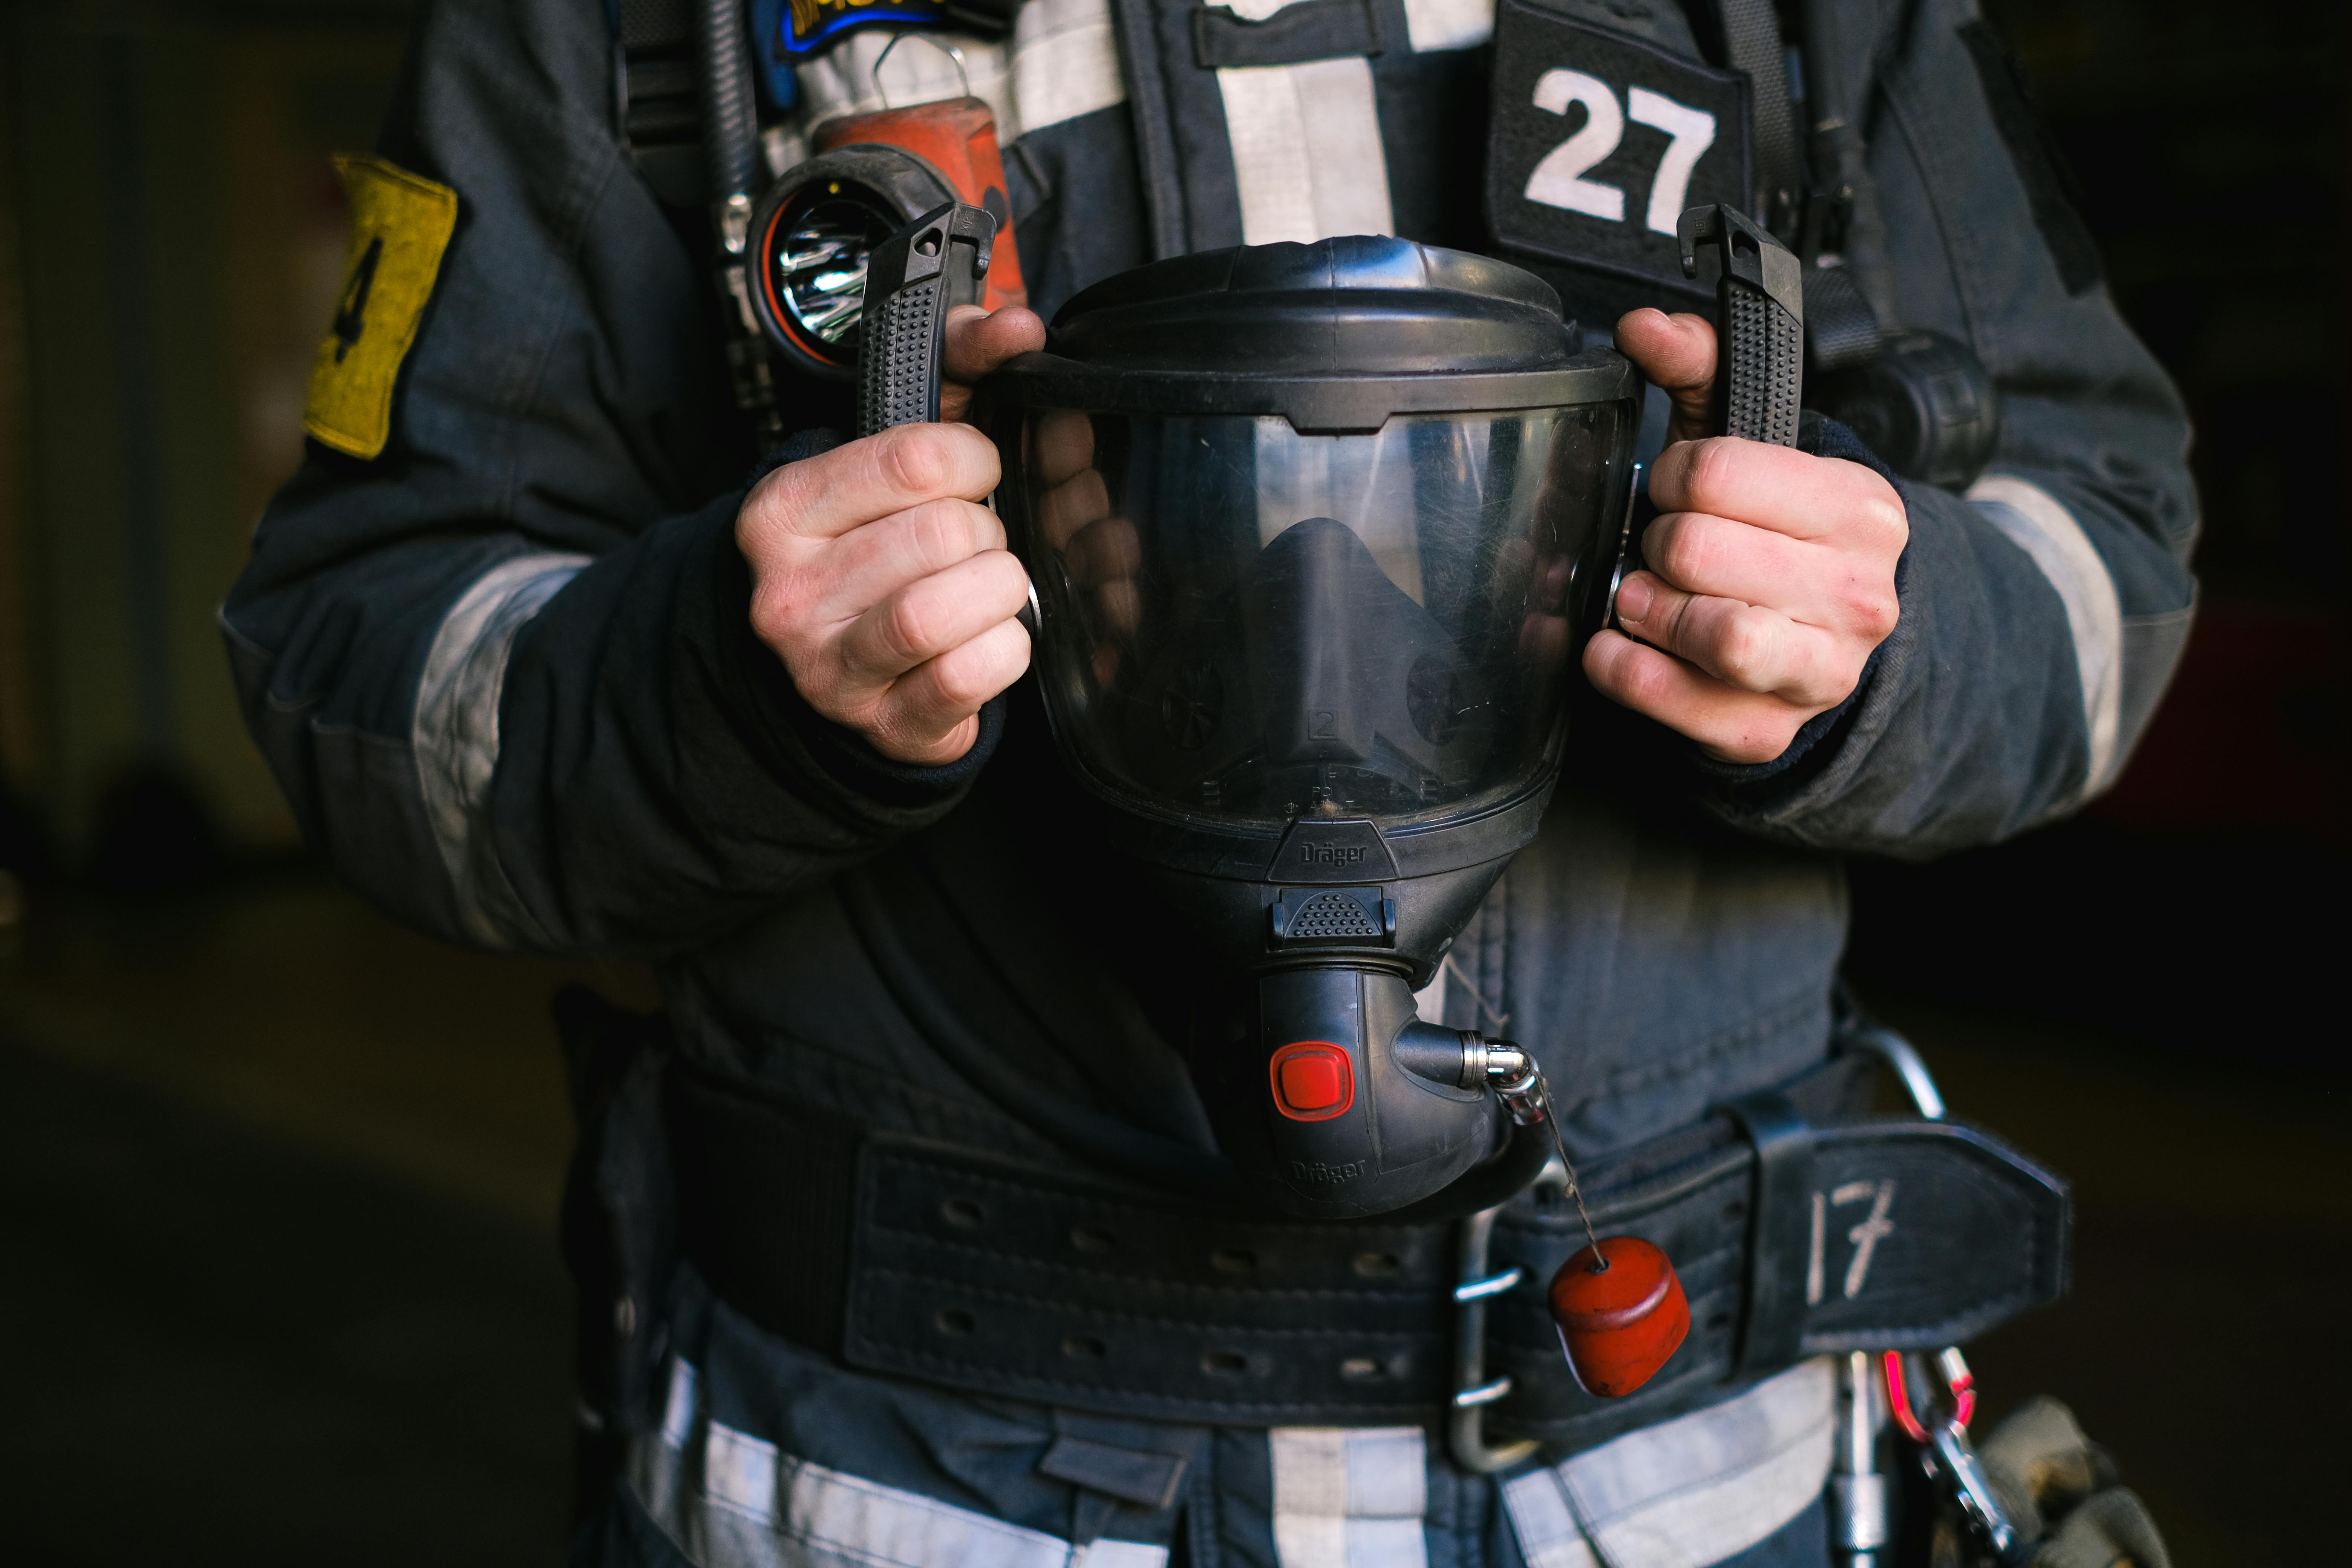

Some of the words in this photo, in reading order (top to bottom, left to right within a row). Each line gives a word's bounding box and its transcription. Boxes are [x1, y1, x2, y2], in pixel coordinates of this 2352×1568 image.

[1524, 67, 1718, 237] 27
[1313, 711, 1335, 739] 2
[1301, 842, 1368, 867] Dräger
[1291, 1159, 1366, 1184] Dräger
[1807, 1179, 1897, 1307] 17
